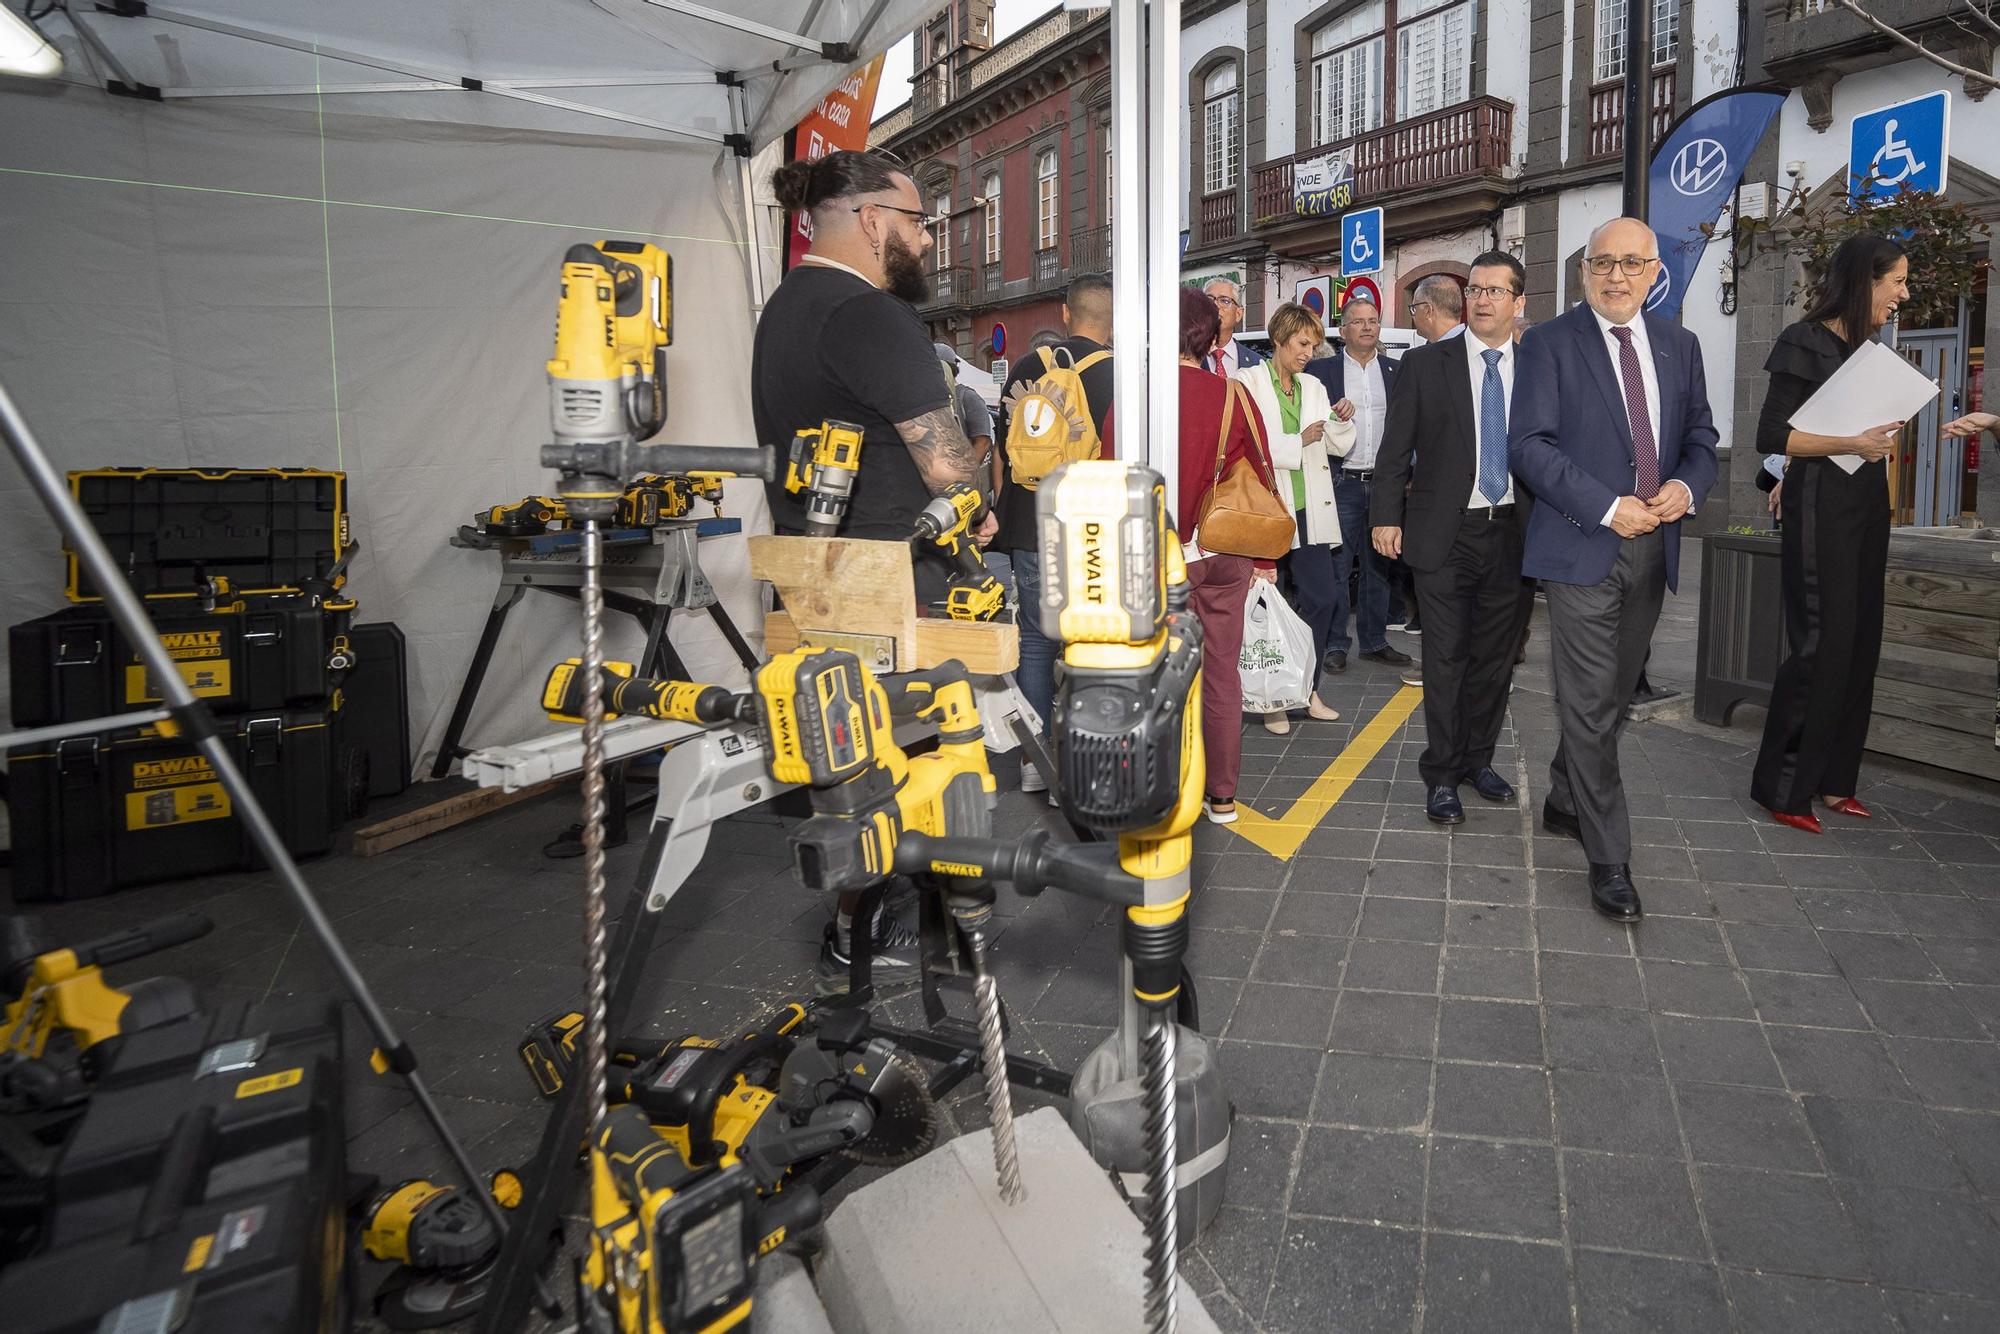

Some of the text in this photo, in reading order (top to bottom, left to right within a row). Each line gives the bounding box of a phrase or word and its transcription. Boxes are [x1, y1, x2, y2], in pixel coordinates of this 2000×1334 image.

[1309, 191, 1328, 215] 277
[1331, 183, 1352, 210] 958
[158, 630, 222, 650] WALT
[133, 756, 212, 777] DEWAL
